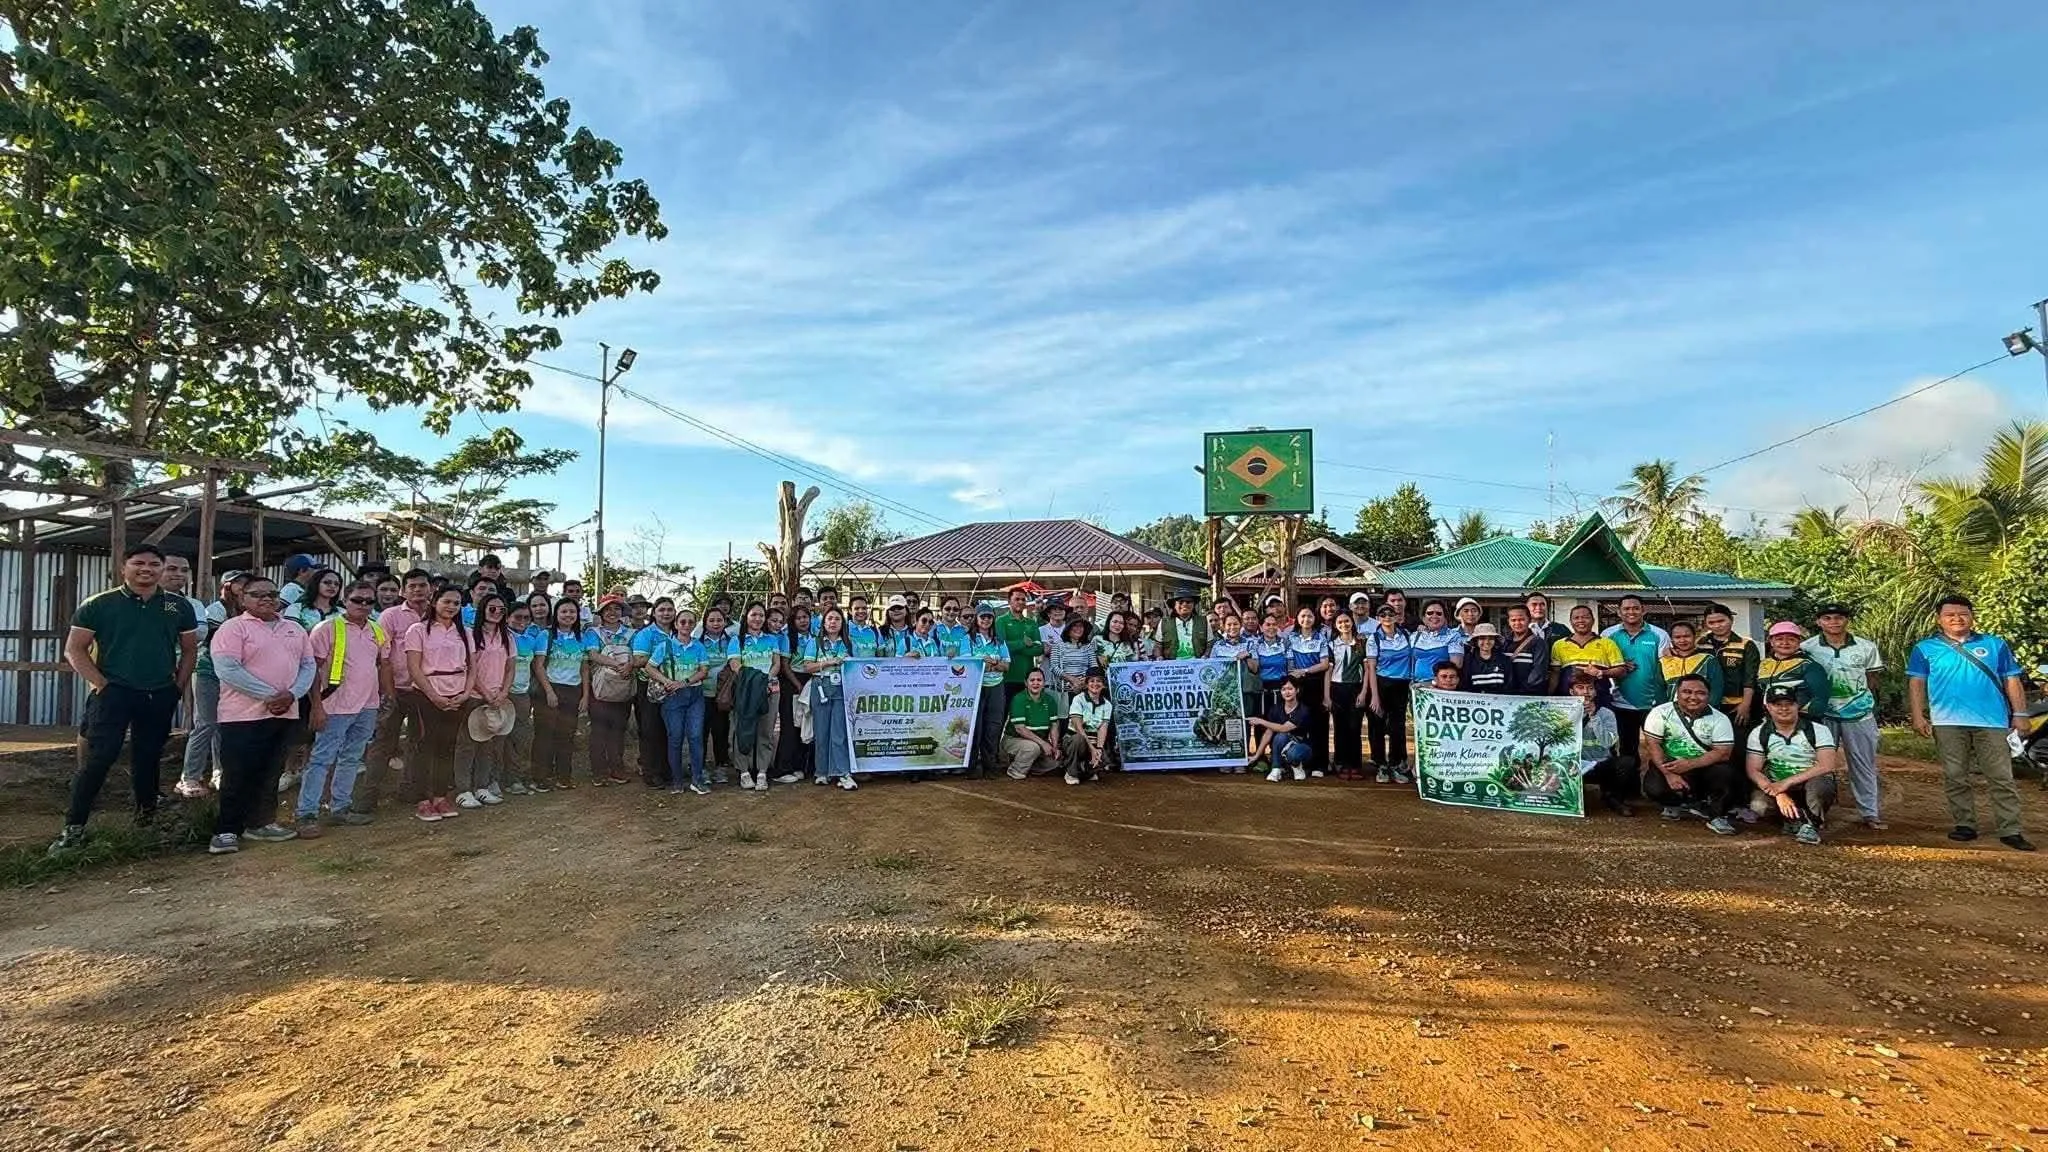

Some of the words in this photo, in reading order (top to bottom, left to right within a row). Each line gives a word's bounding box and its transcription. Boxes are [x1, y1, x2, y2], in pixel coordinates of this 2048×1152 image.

[856, 695, 914, 714] ARBOR
[919, 693, 951, 713] DAY
[951, 698, 974, 708] 2026
[1135, 691, 1182, 711] ARBOR
[1186, 690, 1213, 709] DAY
[1441, 697, 1486, 706] CELEBRATING
[1425, 703, 1505, 726] ARBOR
[1425, 721, 1467, 741] DAY
[1471, 728, 1503, 740] 2026
[1460, 747, 1488, 760] Klima
